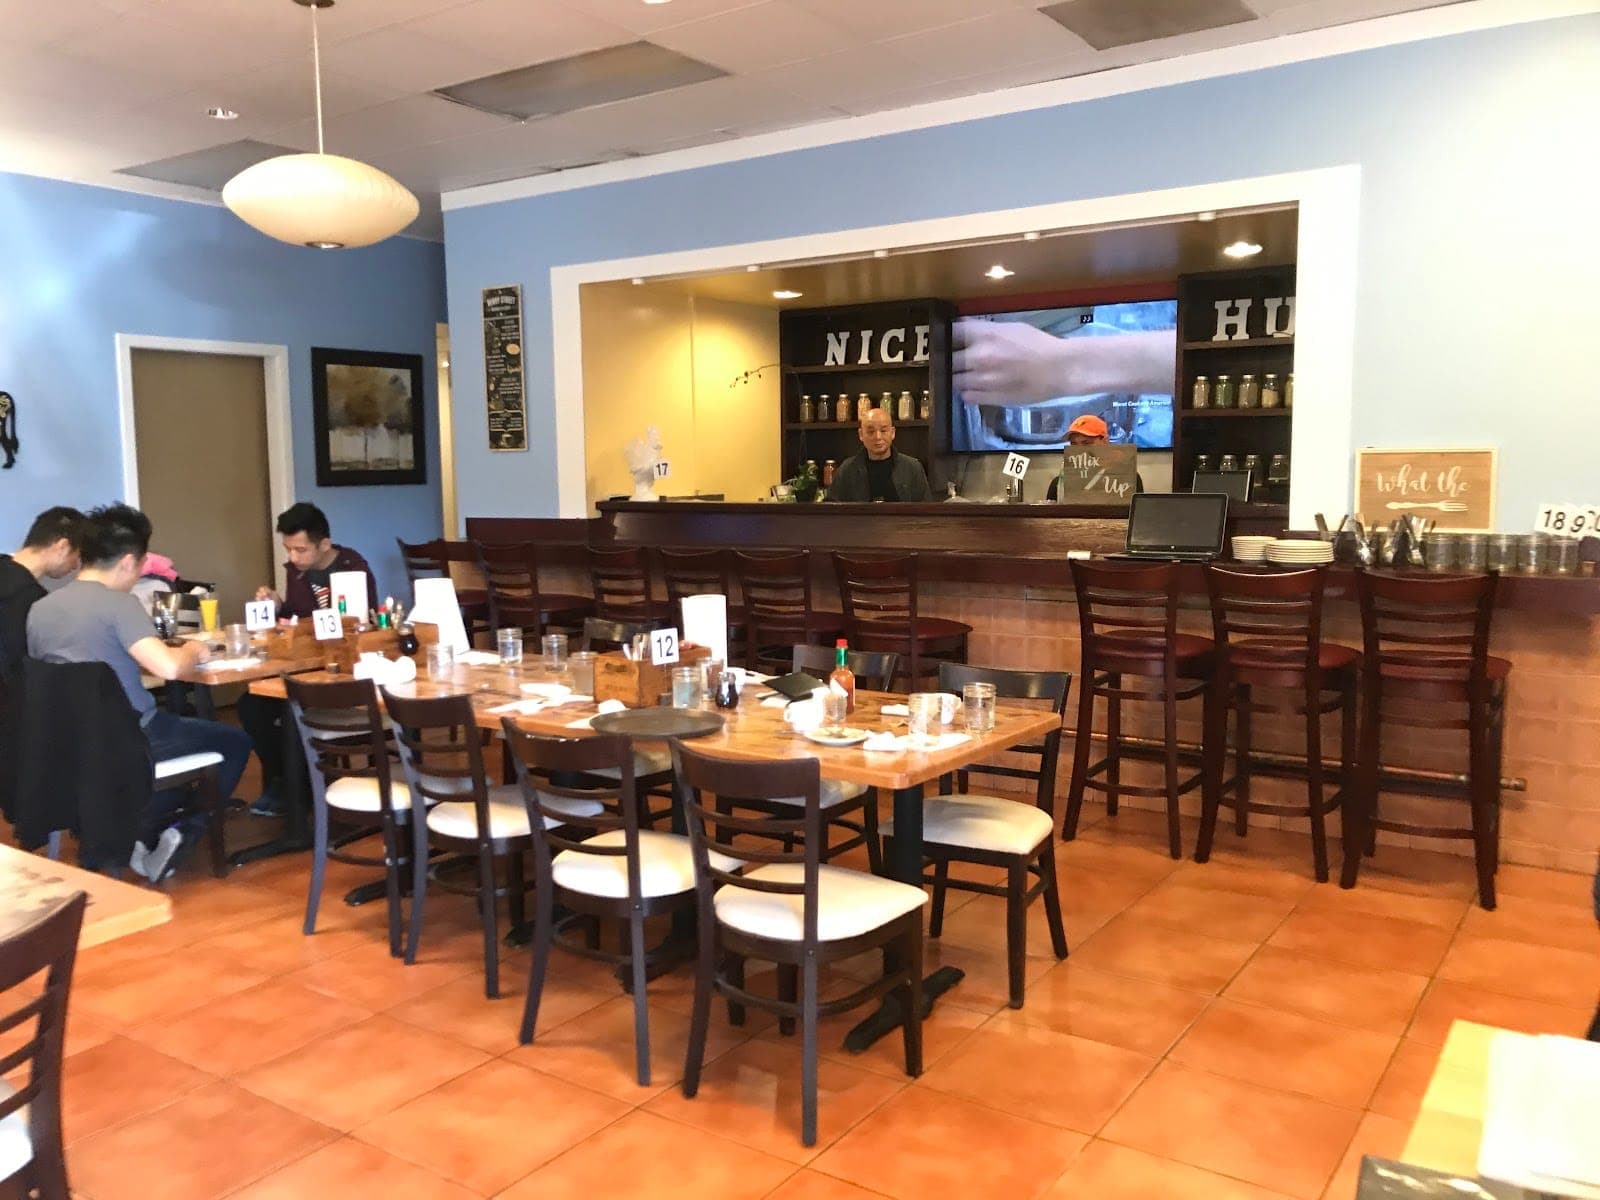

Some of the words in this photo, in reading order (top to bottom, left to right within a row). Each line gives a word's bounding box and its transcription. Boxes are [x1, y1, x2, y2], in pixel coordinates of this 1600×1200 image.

[1212, 296, 1296, 341] HU
[824, 325, 930, 366] NICE
[655, 462, 668, 476] 17
[1010, 457, 1025, 475] 16
[1068, 452, 1101, 470] Mix
[1103, 475, 1130, 498] Up
[1437, 465, 1471, 497] the
[1544, 509, 1566, 530] 18
[252, 606, 269, 624] 14
[320, 614, 337, 633] 13
[656, 635, 674, 658] 12
